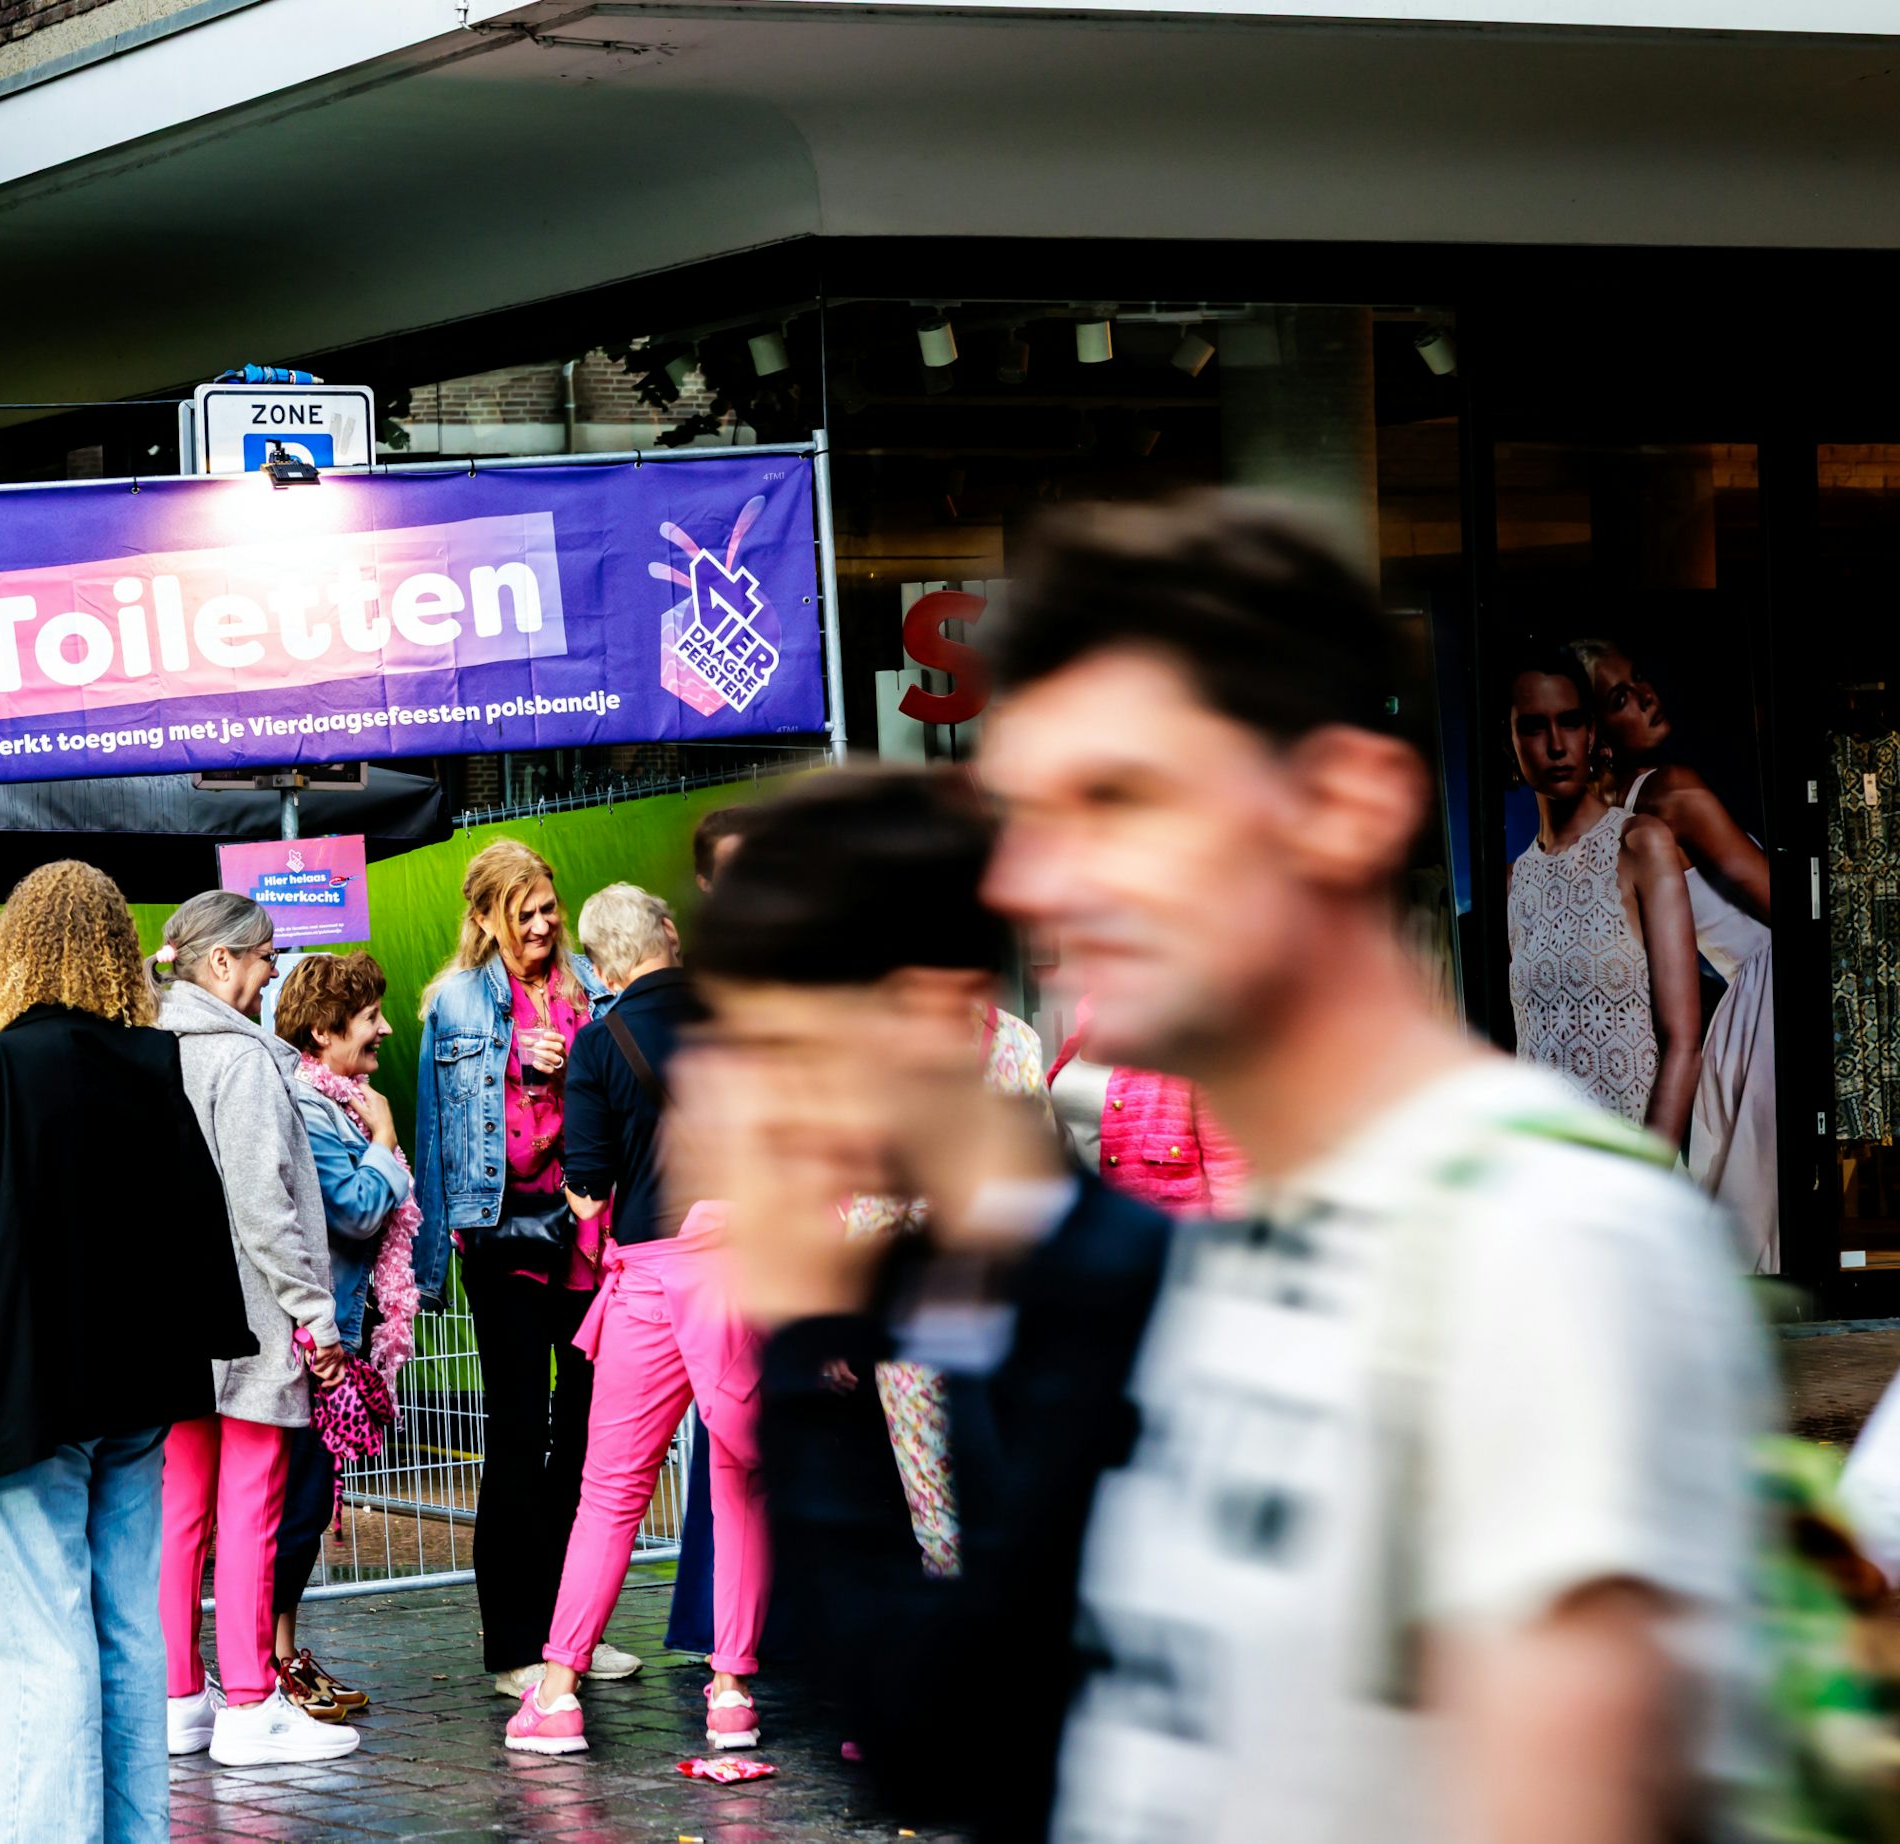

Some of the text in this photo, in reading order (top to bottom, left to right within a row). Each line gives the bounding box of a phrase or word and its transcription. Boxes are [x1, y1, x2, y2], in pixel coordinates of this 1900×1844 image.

[252, 404, 323, 425] ZONE
[678, 638, 748, 706] FEESTEN
[689, 625, 758, 692] DAAGSE
[57, 725, 163, 753] toegang
[169, 719, 218, 741] met
[219, 718, 245, 744] je
[248, 704, 481, 737] Vierdaagsefeesten
[486, 690, 621, 724] polsbandje
[255, 890, 341, 904] uitverkocht
[264, 873, 327, 886] Hier helaas
